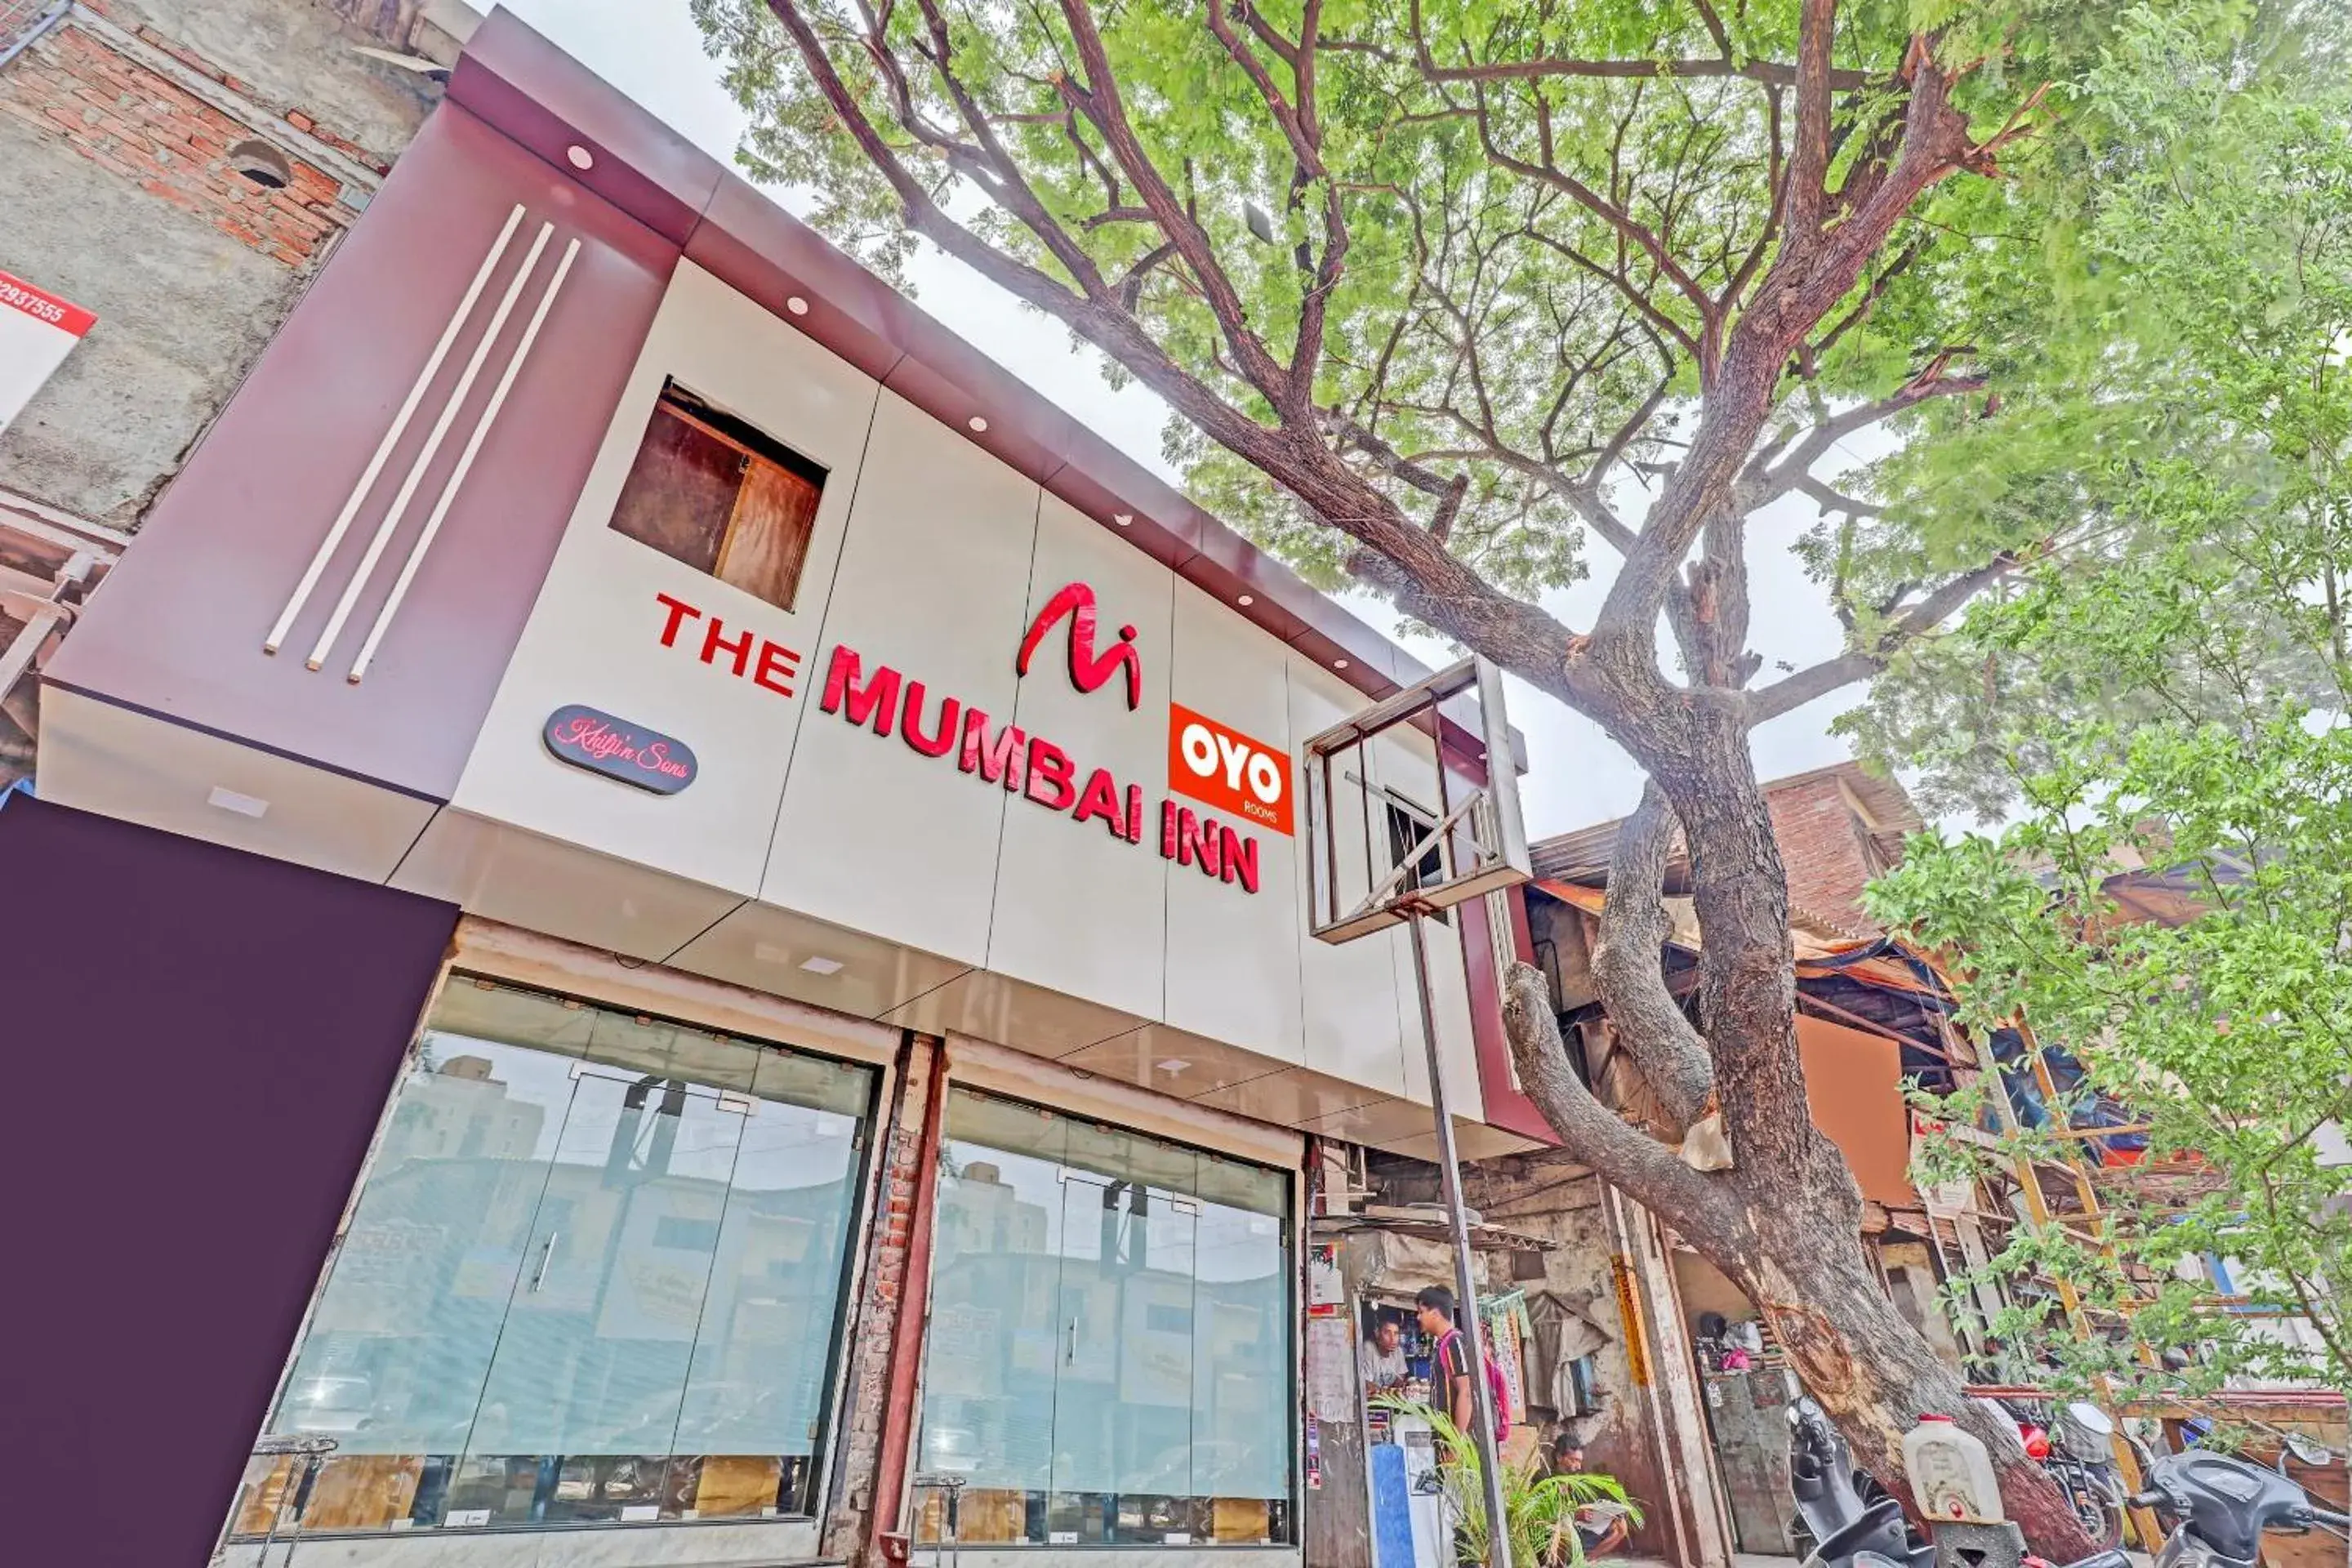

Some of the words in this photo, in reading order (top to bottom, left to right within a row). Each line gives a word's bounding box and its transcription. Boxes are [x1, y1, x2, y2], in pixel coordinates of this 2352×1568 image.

[0, 280, 65, 323] 2937555
[657, 592, 801, 698] THE
[819, 644, 1143, 844] MUMBAI
[1160, 799, 1258, 893] INN
[1181, 724, 1282, 804] OYO
[1244, 800, 1278, 824] ROOMS
